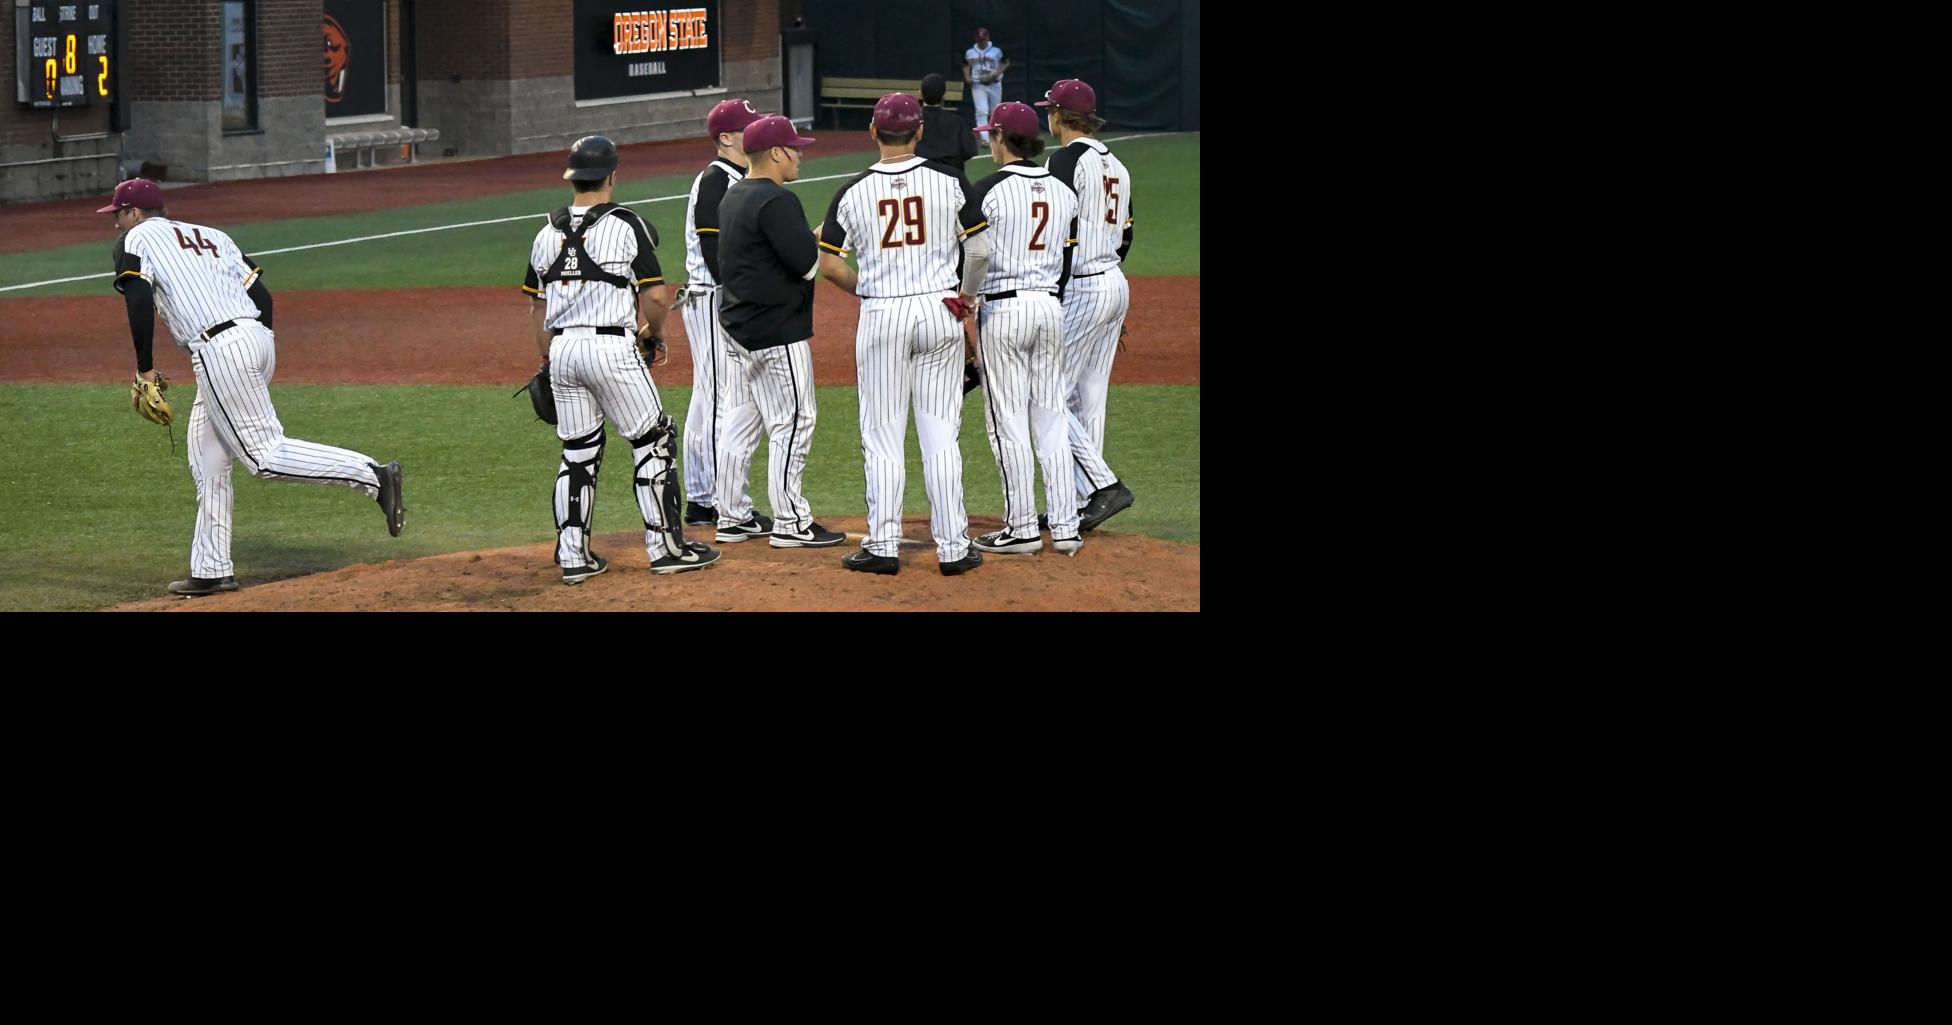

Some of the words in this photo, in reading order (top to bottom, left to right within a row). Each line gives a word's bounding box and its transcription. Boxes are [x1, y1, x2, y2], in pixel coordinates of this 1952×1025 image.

[32, 7, 46, 21] BALL
[59, 6, 76, 21] STRIKE
[613, 10, 667, 54] OREGON
[668, 8, 707, 50] STATE
[33, 37, 57, 57] GUEST
[65, 34, 77, 74] 8
[87, 35, 106, 54] HOME
[98, 55, 109, 96] 2
[628, 61, 667, 77] BASEBALL
[878, 195, 926, 249] 29
[1027, 201, 1050, 251] 2
[173, 227, 220, 258] 44
[564, 257, 578, 270] 28
